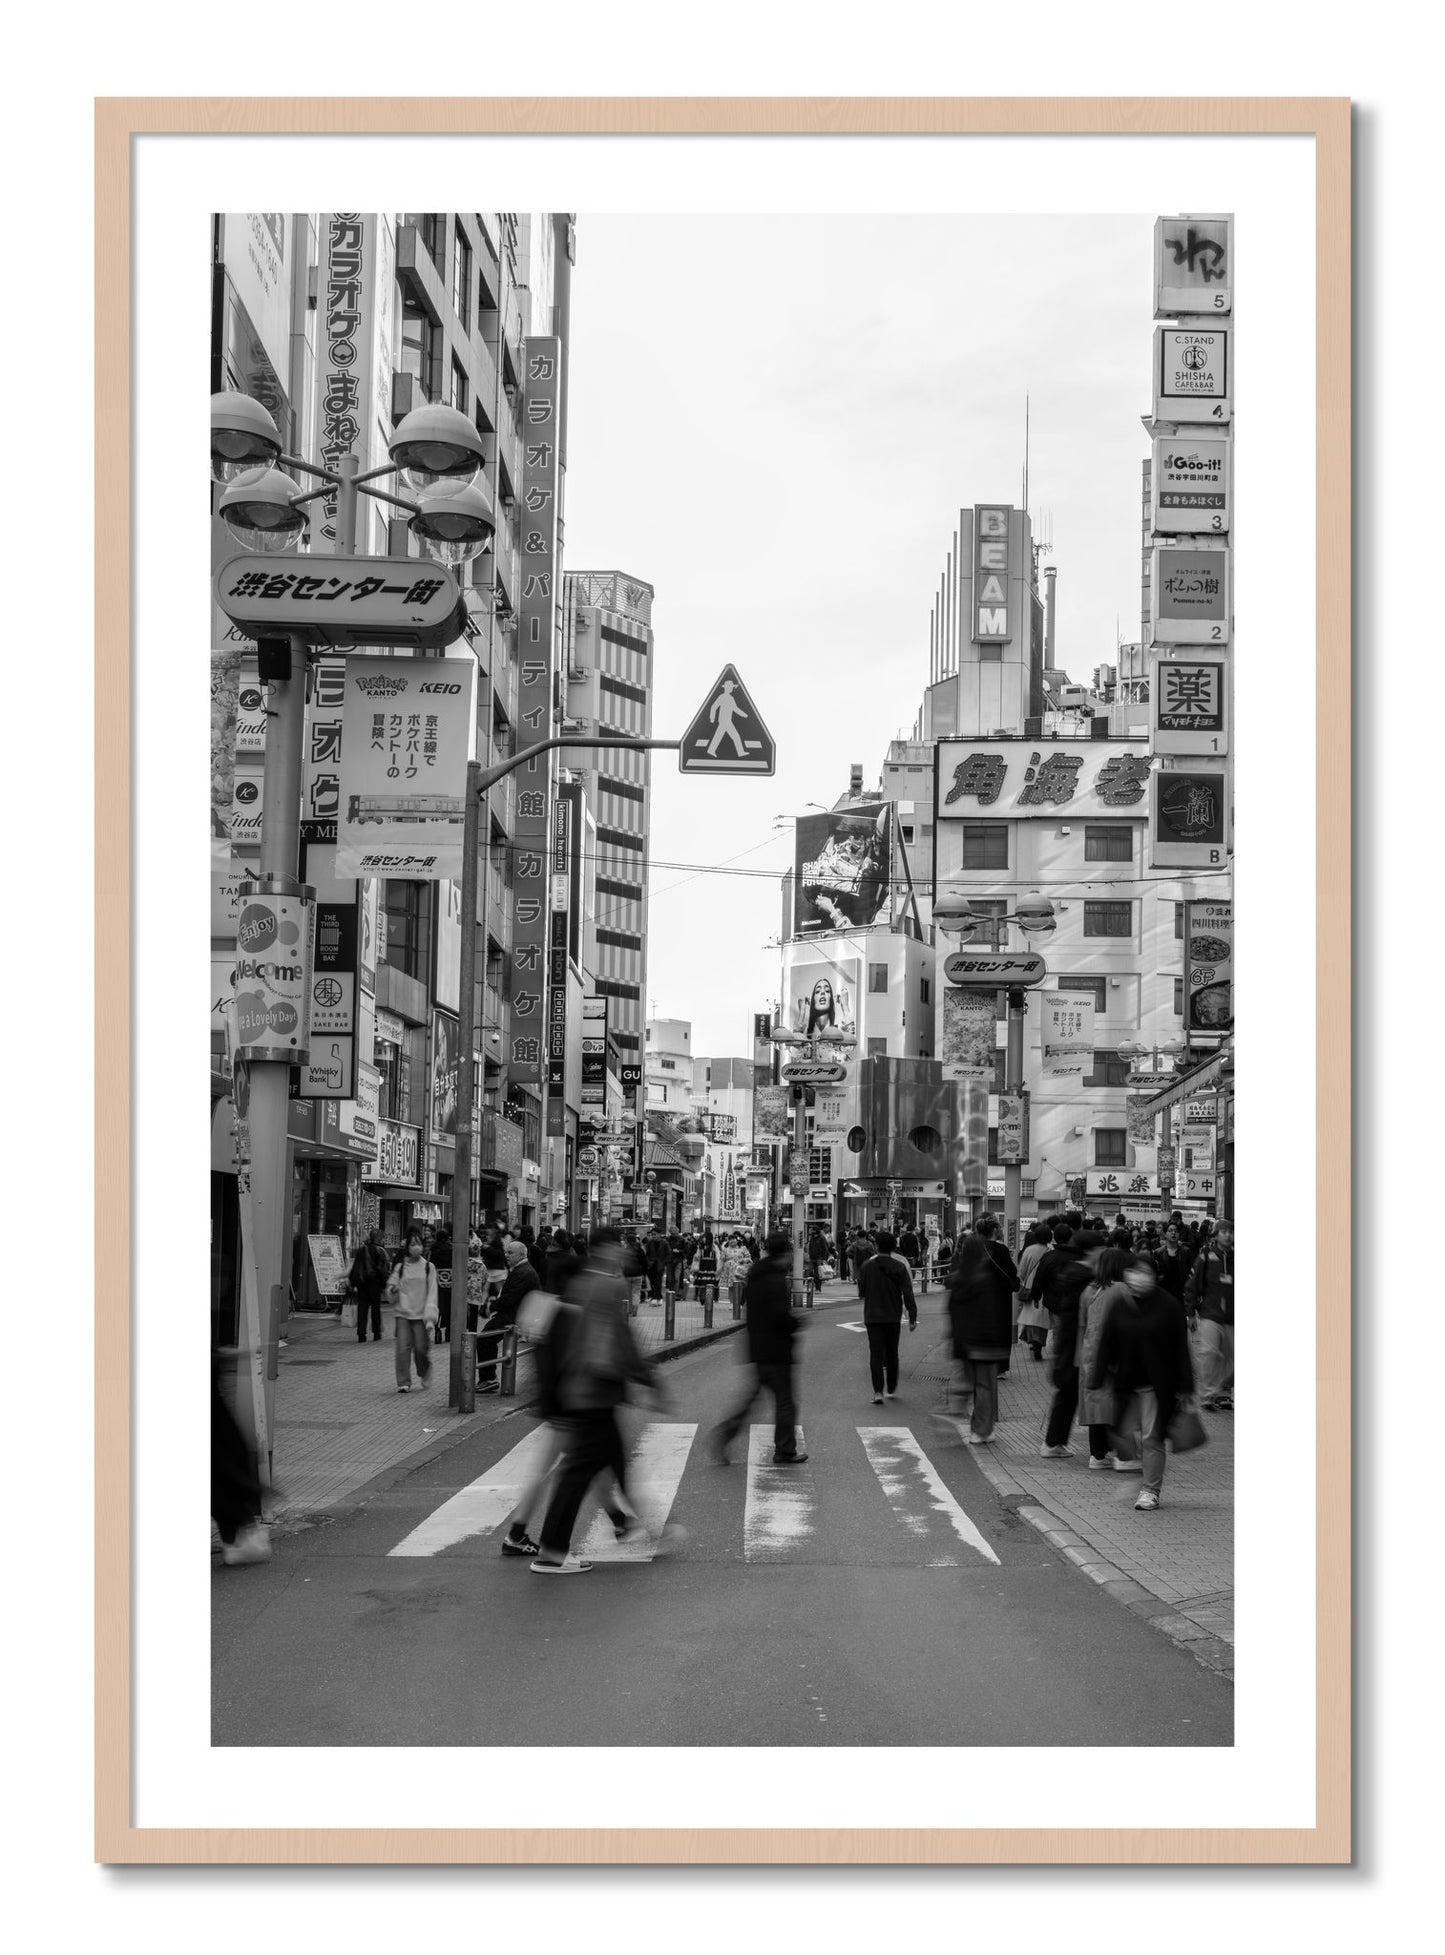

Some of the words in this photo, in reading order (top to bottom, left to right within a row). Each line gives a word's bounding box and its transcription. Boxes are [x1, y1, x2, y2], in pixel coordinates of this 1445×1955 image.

[327, 221, 363, 341] カラオケ
[1214, 295, 1224, 308] 5
[1175, 336, 1214, 344] C.STAND
[1175, 372, 1214, 381] SHISHA
[1213, 405, 1223, 418] 4
[1174, 456, 1221, 470] Goo-it!
[1163, 495, 1222, 505] 全身もみほぐし
[1212, 515, 1222, 529] 3
[978, 508, 1009, 636] BEAM
[228, 572, 445, 605] 渋谷センター街
[1212, 626, 1221, 639] 2
[419, 683, 461, 694] KEIO
[1167, 668, 1211, 713] 薬
[371, 714, 385, 750] 冒険へ
[387, 714, 403, 778] カントーの
[424, 714, 438, 766] 京王線で
[1211, 738, 1218, 751] 1
[1162, 786, 1214, 828] 一蘭
[360, 855, 437, 867] 渋谷センター街
[1210, 850, 1220, 863] B
[240, 915, 275, 946] Enjoy
[236, 959, 303, 981] Welcome
[951, 961, 1040, 972] 渋谷センター街
[1190, 968, 1215, 986] 6F
[251, 1010, 277, 1027] Lovely
[280, 1011, 296, 1024] Day!
[309, 1067, 338, 1076] Whisky
[623, 1070, 640, 1080] GU
